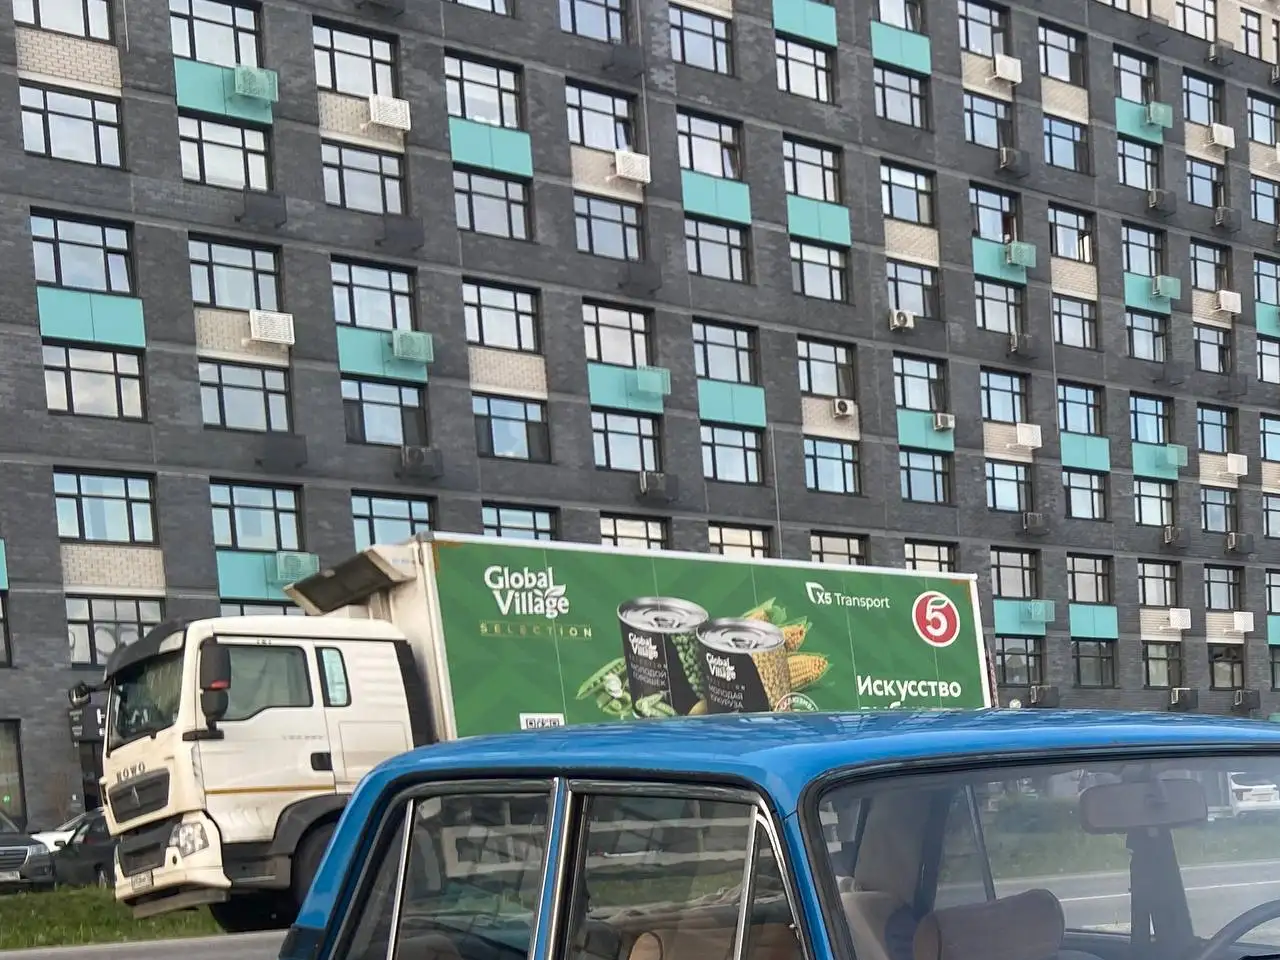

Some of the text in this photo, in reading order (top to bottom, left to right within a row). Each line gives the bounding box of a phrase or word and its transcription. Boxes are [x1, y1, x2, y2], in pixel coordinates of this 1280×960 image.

[484, 565, 555, 589] Global
[816, 591, 891, 611] X5 Transport
[480, 622, 592, 638] SELECTION
[857, 675, 962, 701] Искусство
[116, 761, 145, 782] HOWO
